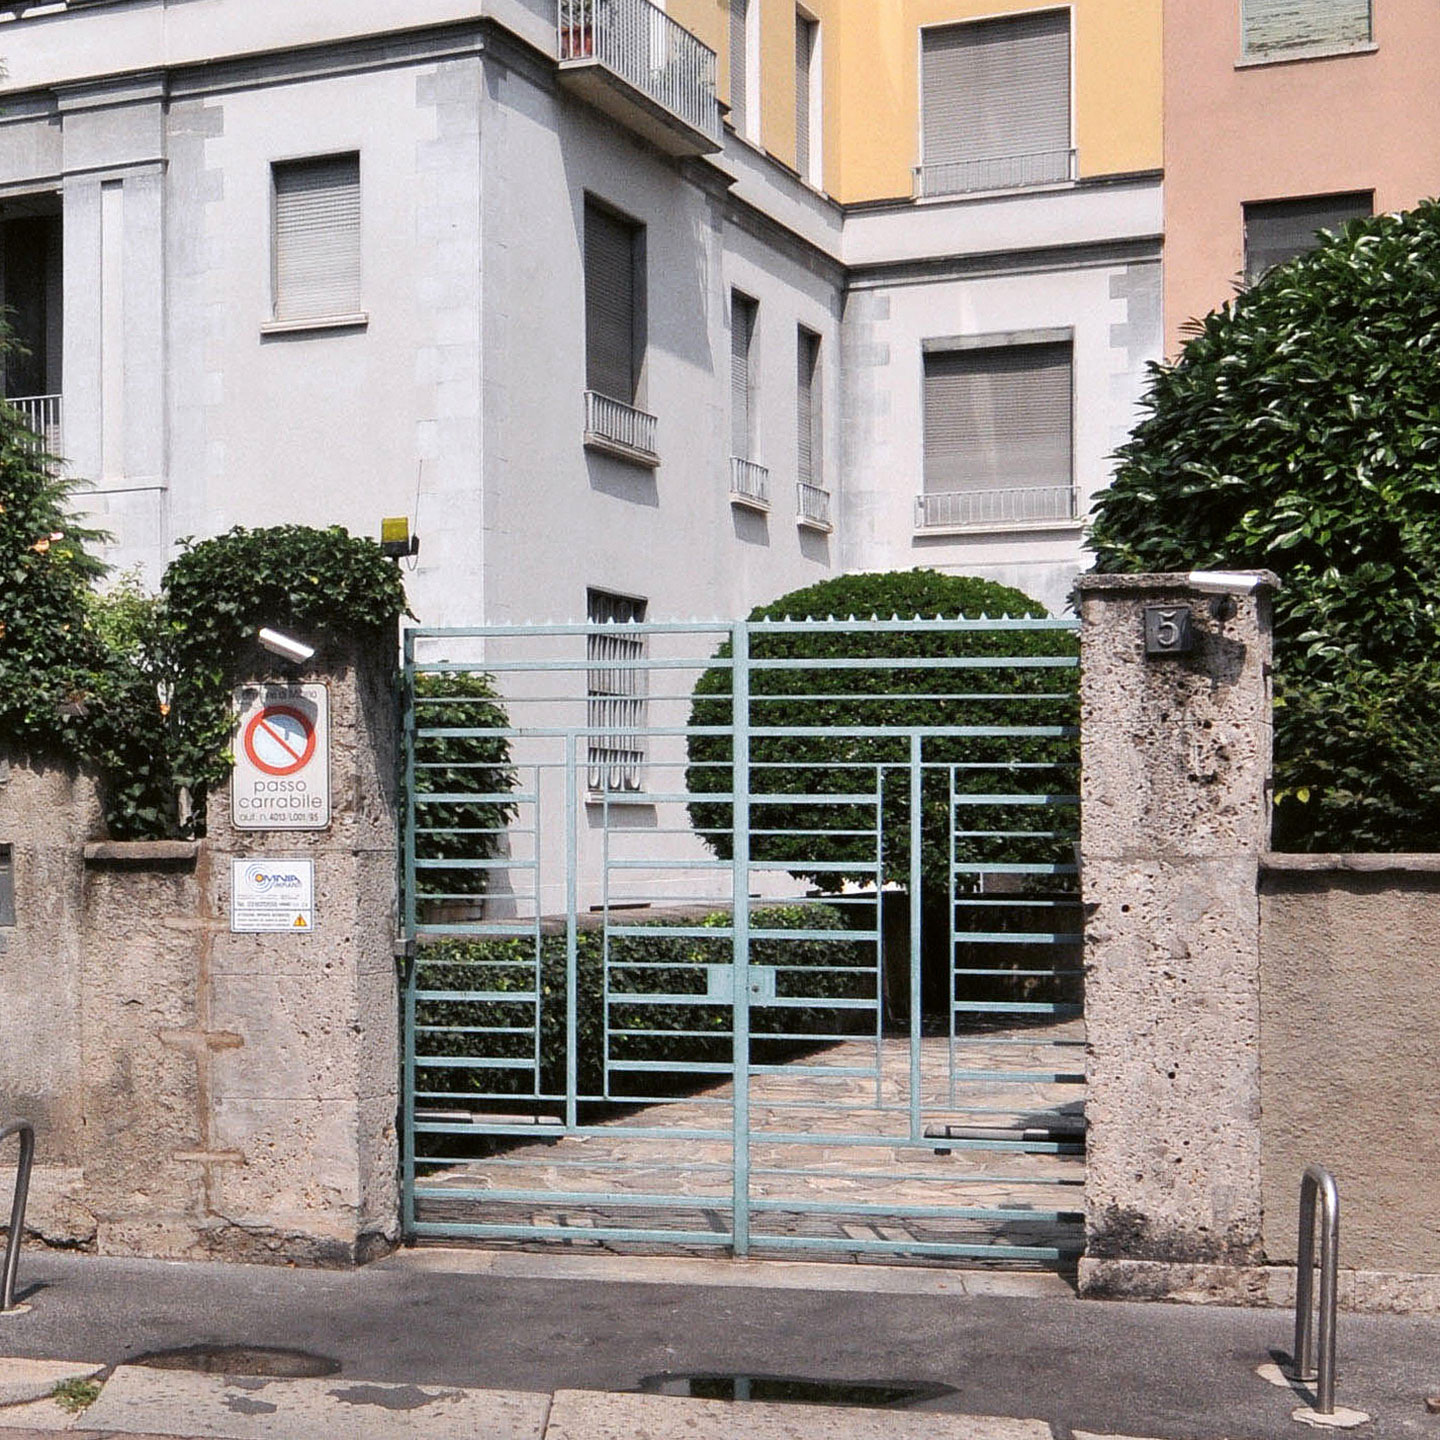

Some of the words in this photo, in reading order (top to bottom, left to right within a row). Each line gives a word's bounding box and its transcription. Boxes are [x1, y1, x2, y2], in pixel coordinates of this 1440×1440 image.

[1158, 611, 1179, 646] 5
[254, 780, 307, 794] passo
[238, 796, 323, 809] carrabile
